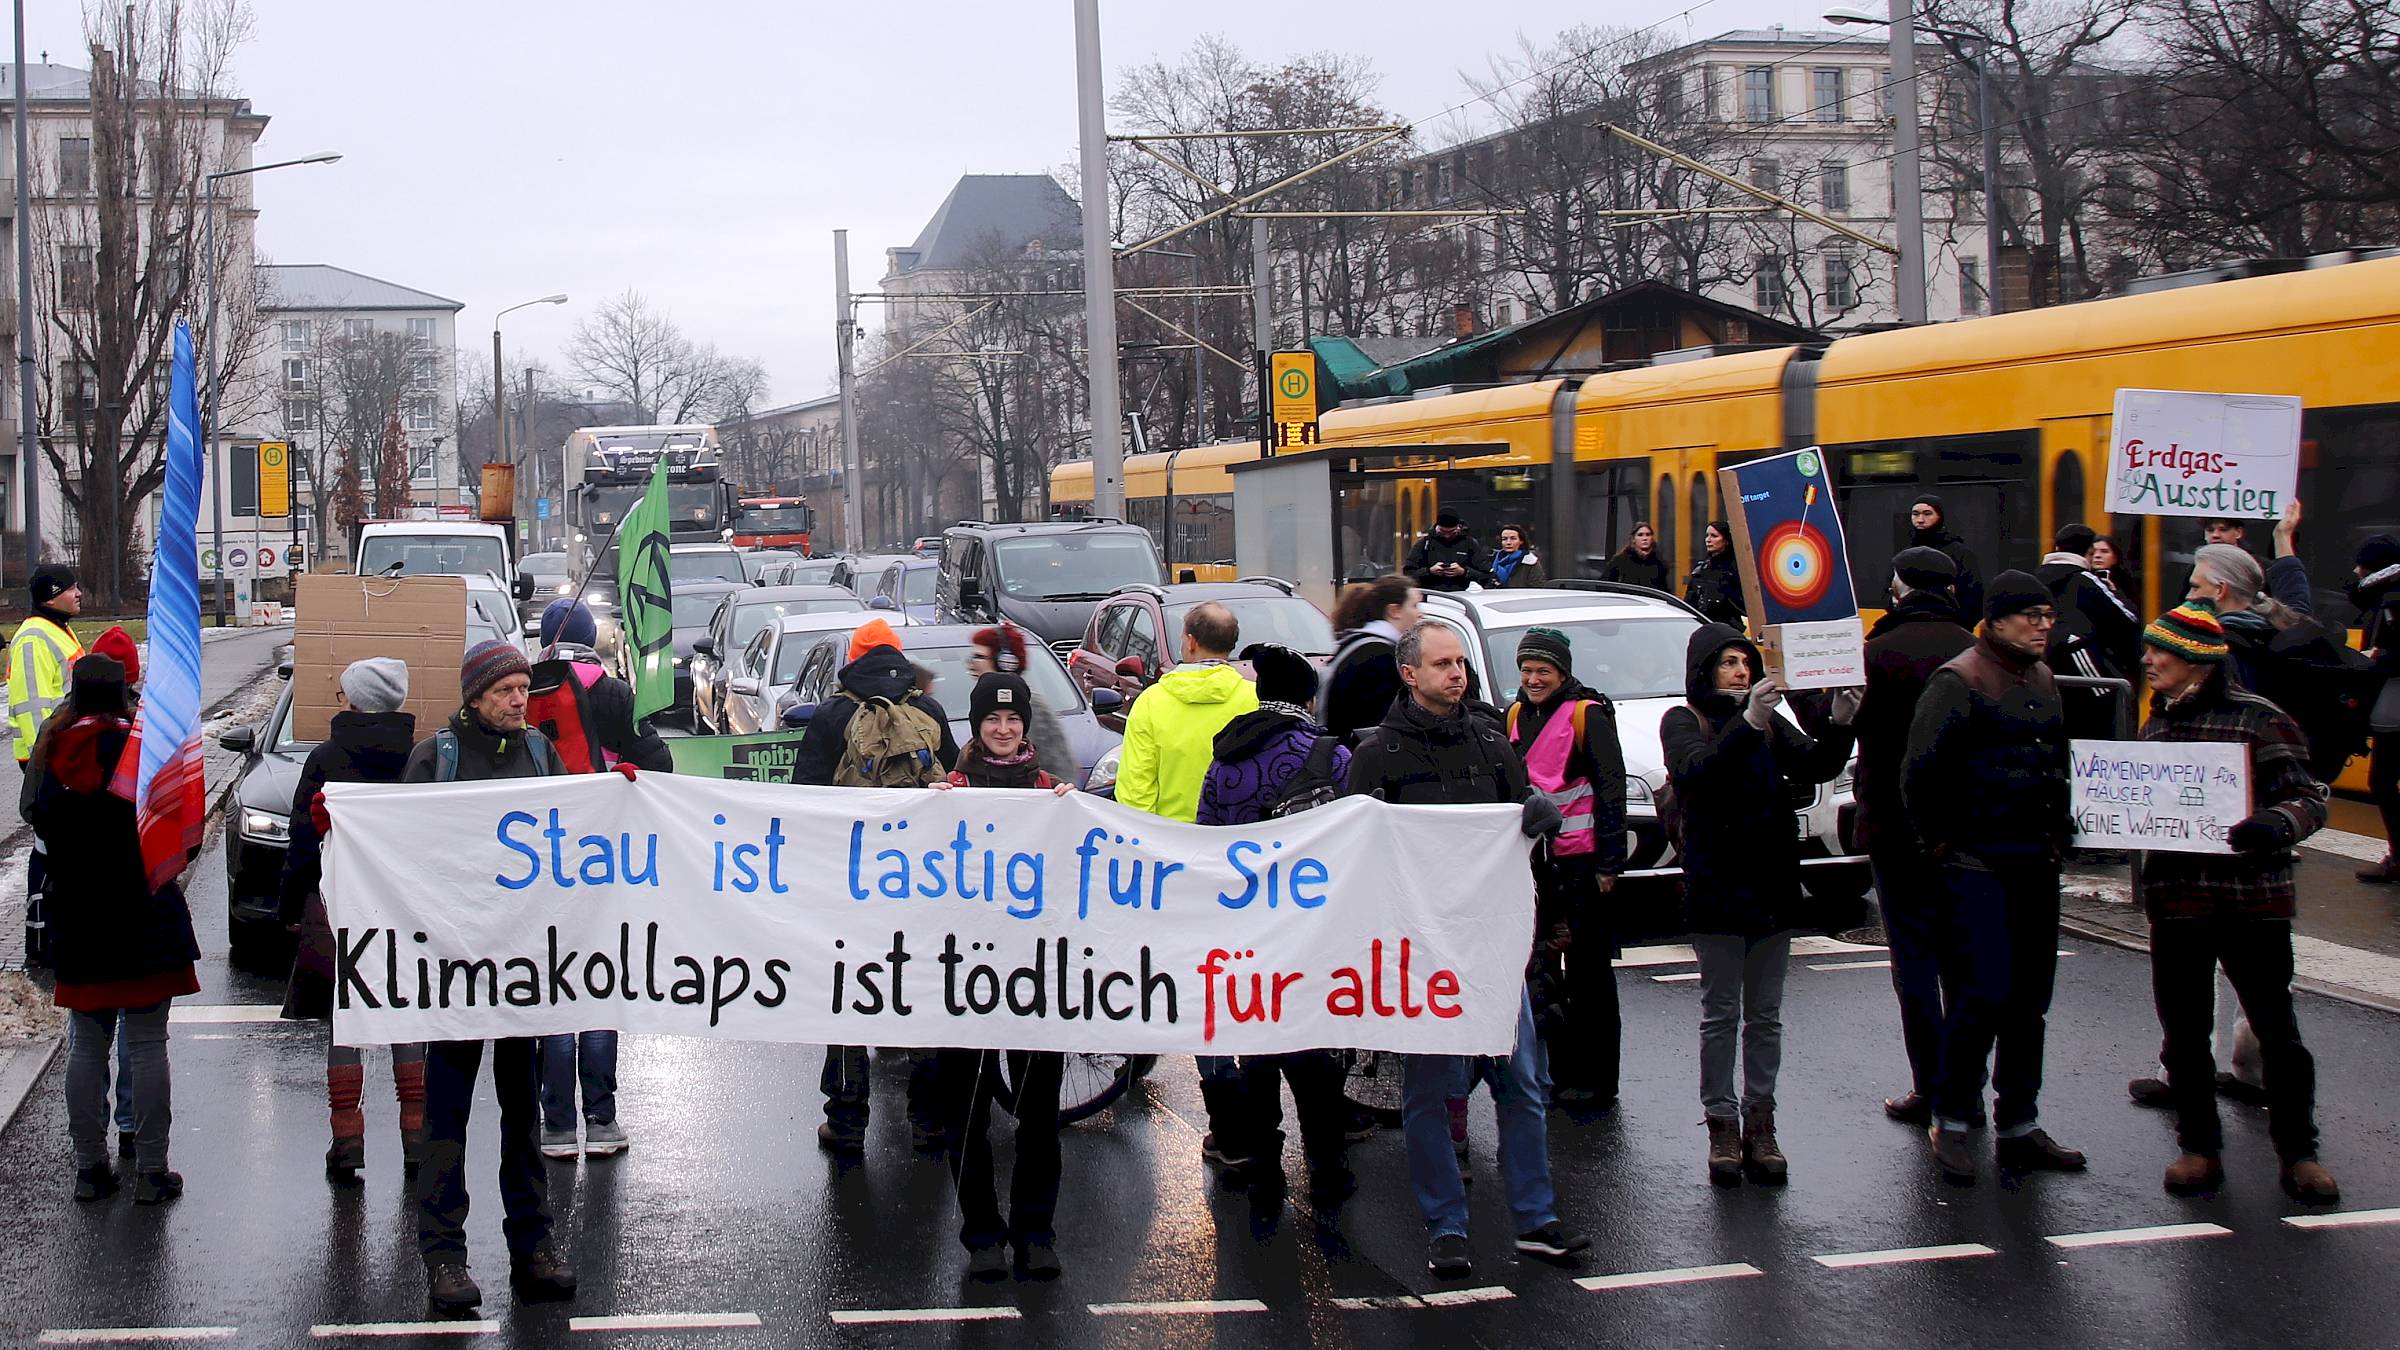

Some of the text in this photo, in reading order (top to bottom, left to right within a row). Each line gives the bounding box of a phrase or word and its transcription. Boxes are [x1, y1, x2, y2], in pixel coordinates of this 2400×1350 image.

[2125, 439, 2238, 480] Erdgas-
[1749, 490, 1771, 501] target
[2129, 473, 2279, 519] Ausstieg
[2085, 779, 2152, 803] HÄUSER
[2074, 805, 2121, 836] KEINE
[2126, 807, 2190, 839] WAFFEN
[2198, 822, 2232, 844] KRIE
[495, 808, 1330, 920] Stau ist lästig für Sie
[337, 921, 1464, 1046] Klimakollaps ist tödlich für alle
